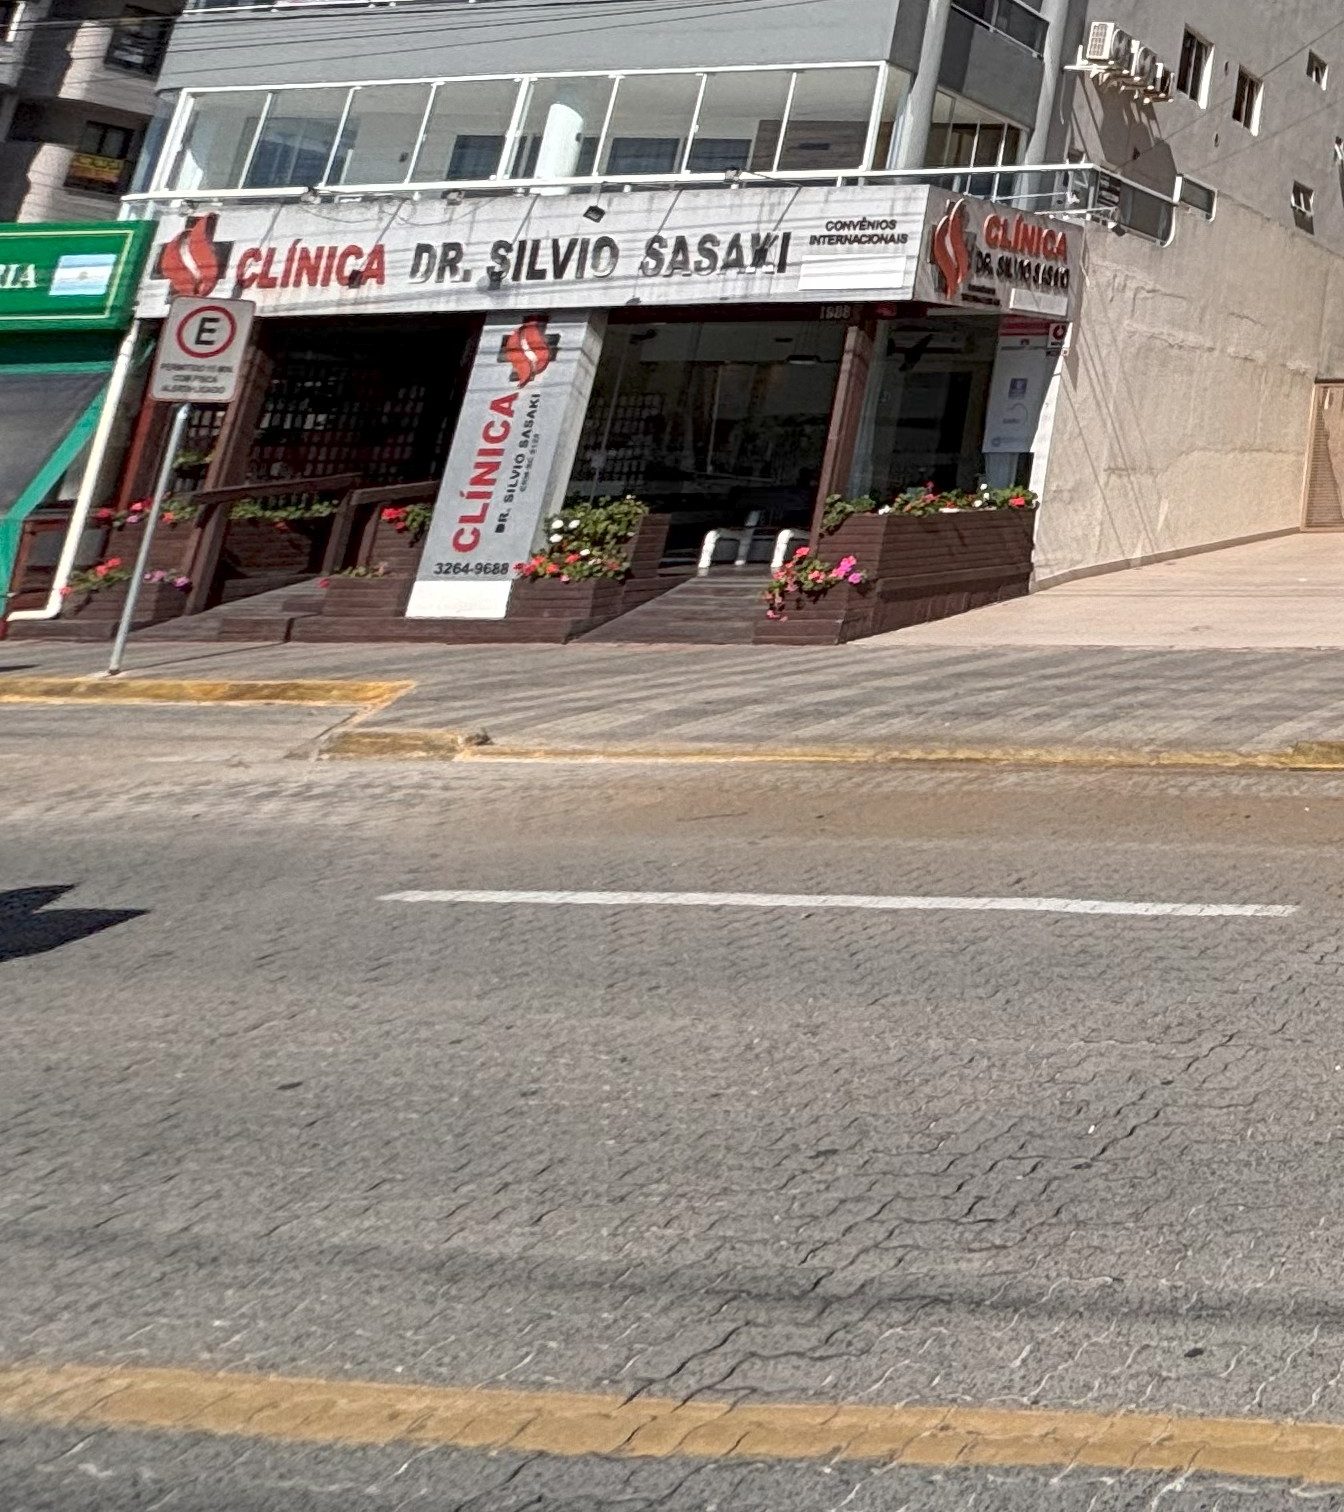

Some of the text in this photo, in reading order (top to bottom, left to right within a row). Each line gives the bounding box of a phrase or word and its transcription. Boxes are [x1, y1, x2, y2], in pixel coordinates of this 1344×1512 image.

[825, 216, 897, 231] CONVÊNIOS
[984, 212, 1068, 265] CLÍNICA
[809, 233, 909, 246] INTERNACIONAIS
[236, 232, 792, 289] CLÍNICA DR. SILVIO SASAKI
[0, 264, 37, 288] IA
[194, 316, 221, 346] E
[503, 452, 525, 504] SILVIO
[518, 393, 541, 448] SASAKI
[452, 392, 519, 554] CLÍNICA
[433, 561, 510, 576] 3264-9688
